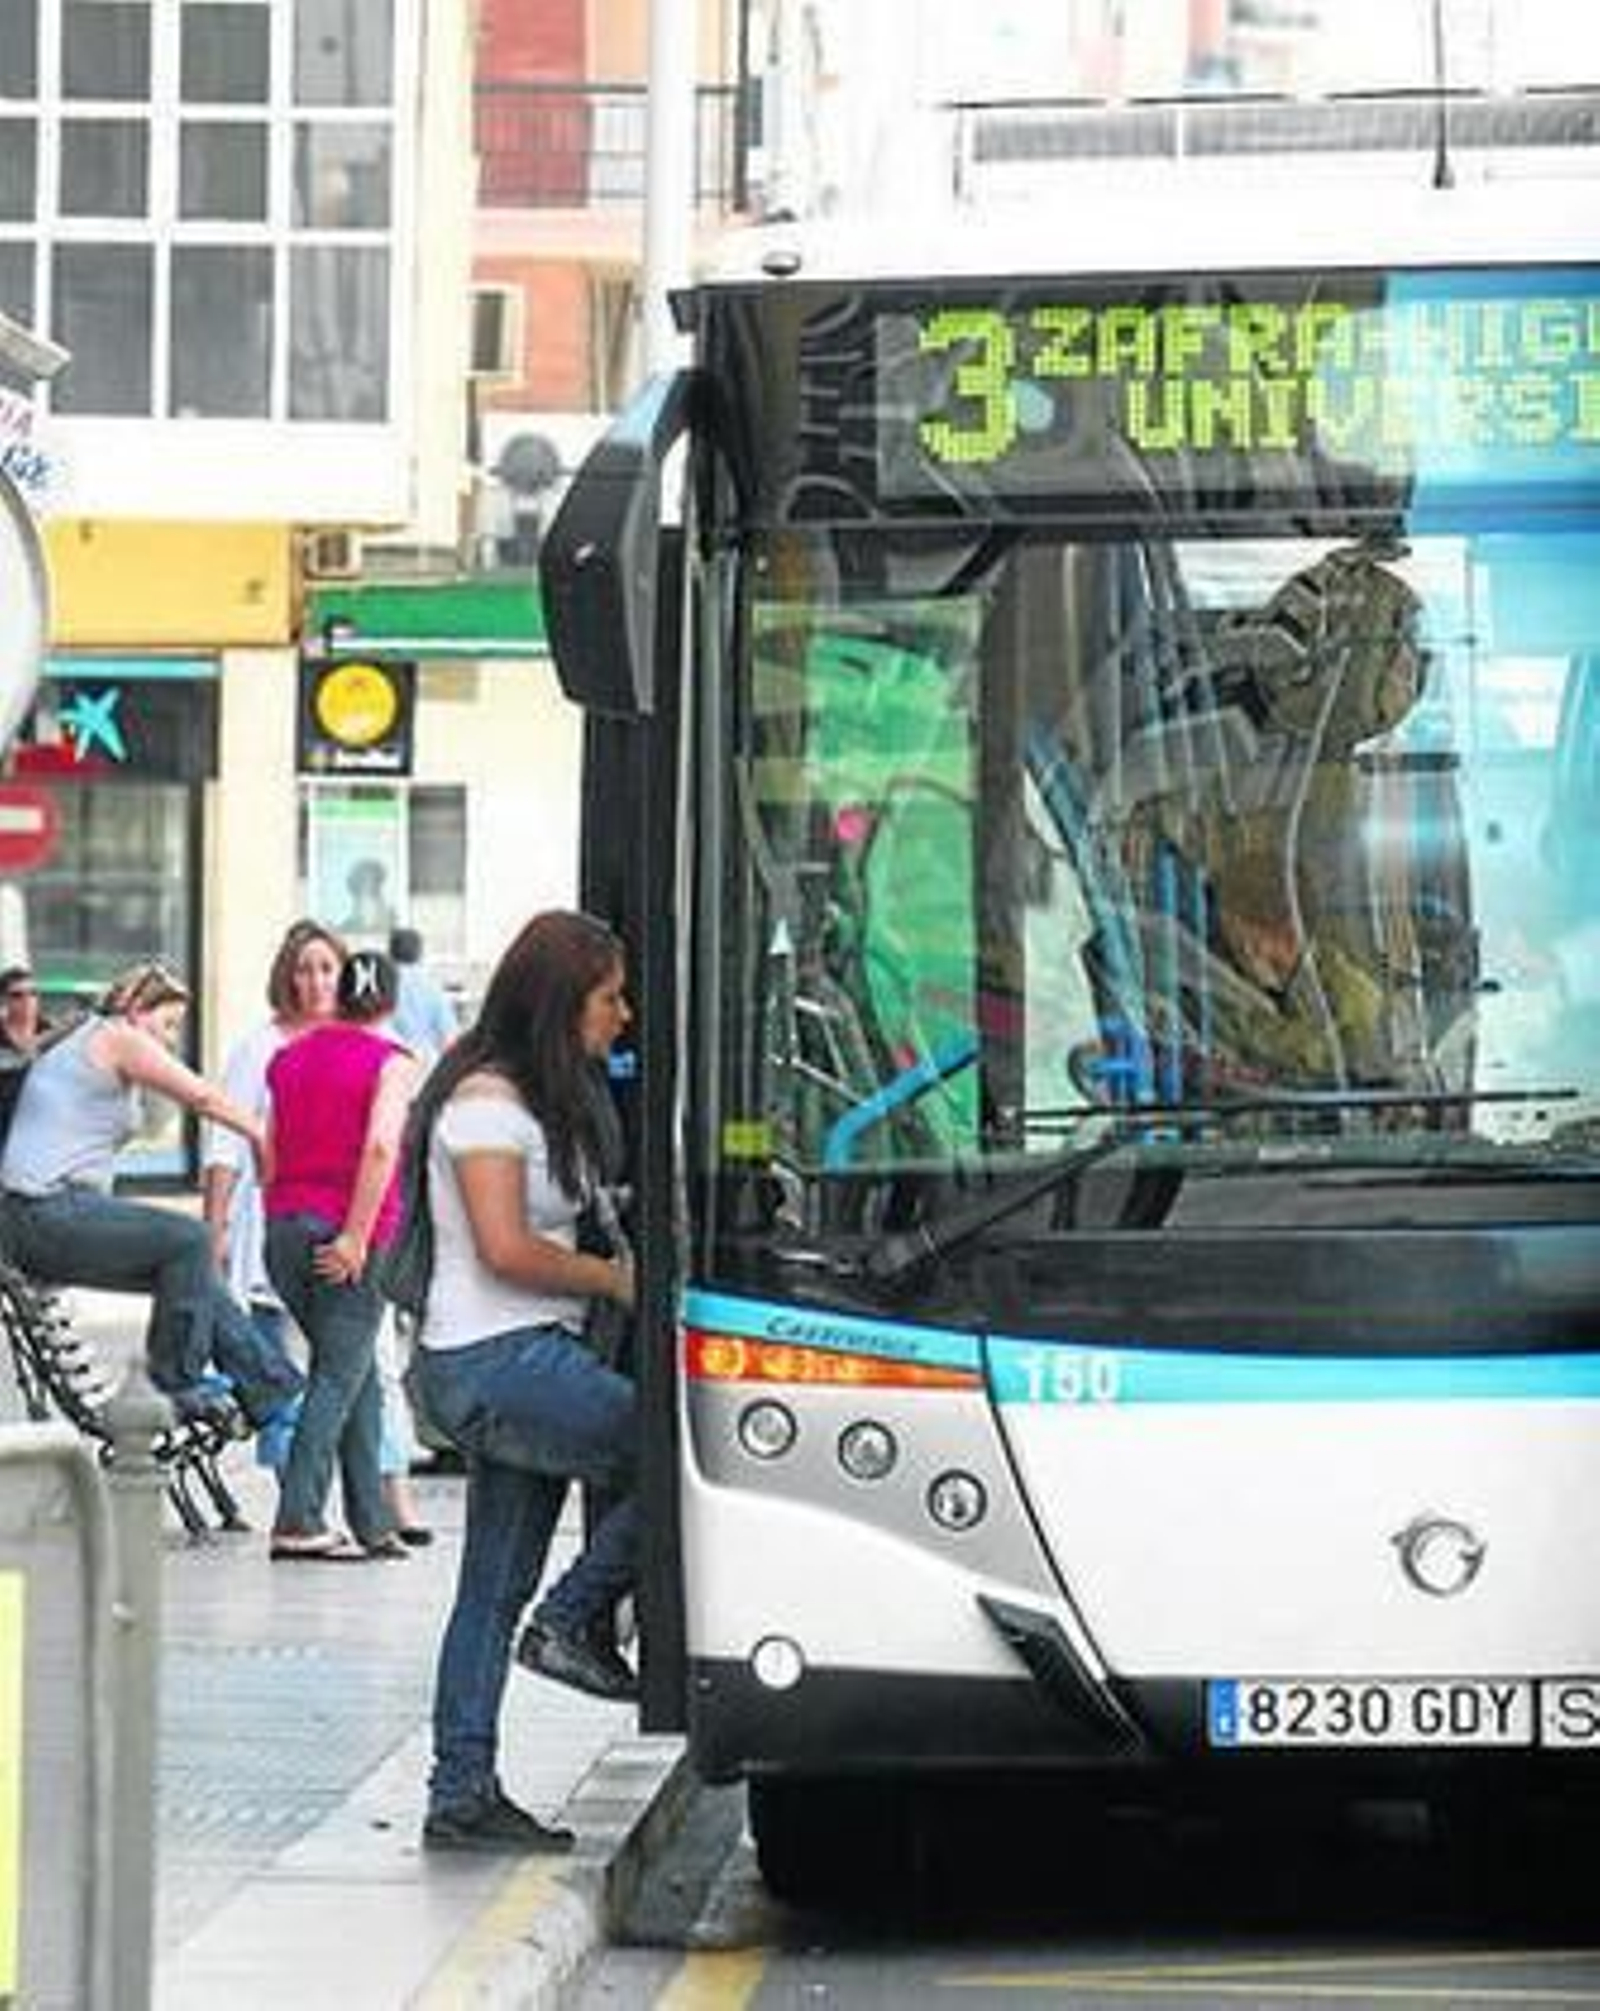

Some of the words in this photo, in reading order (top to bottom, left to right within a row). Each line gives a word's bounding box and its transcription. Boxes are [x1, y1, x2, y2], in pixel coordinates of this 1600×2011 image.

[1033, 299, 1600, 376] ZAFRA-HIG
[920, 307, 1017, 462] 3
[1020, 1349, 1120, 1400] 150
[1248, 1686, 1391, 1737] 8230
[1411, 1686, 1518, 1737] GDY
